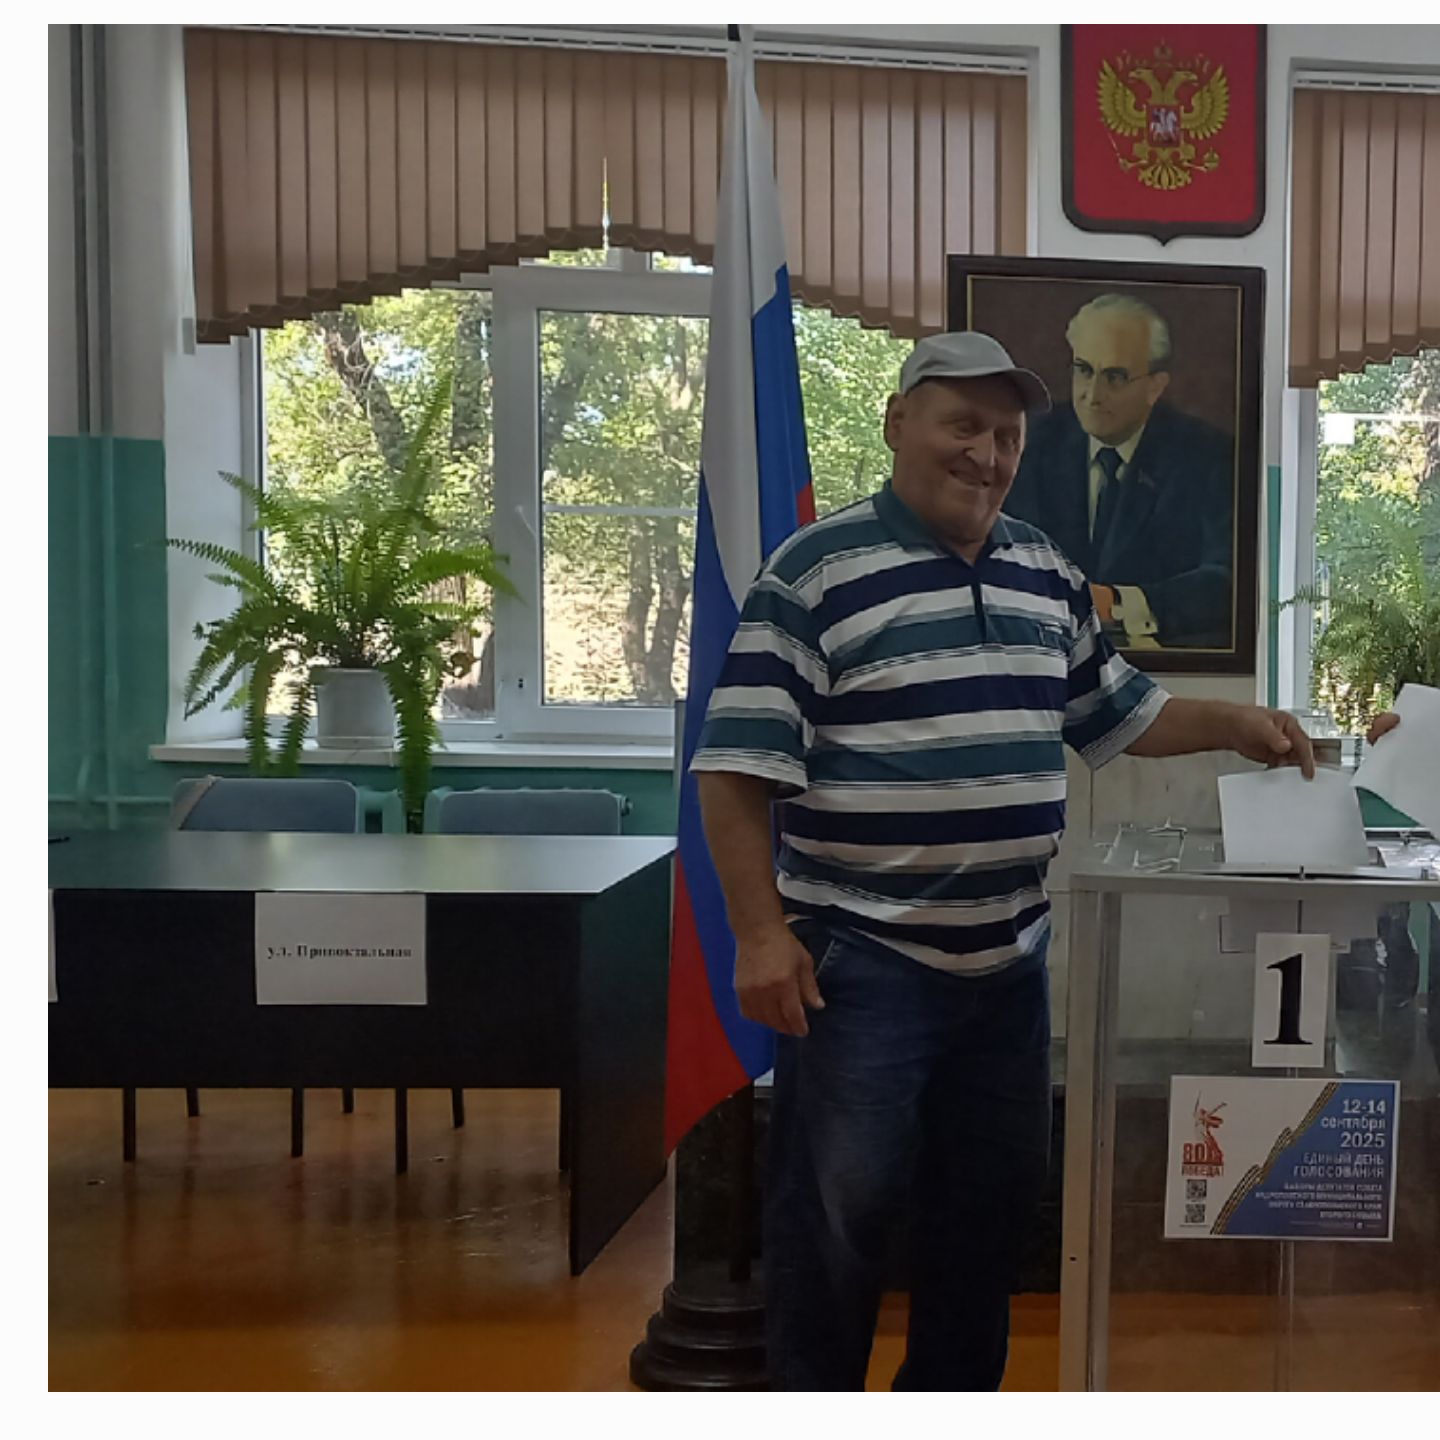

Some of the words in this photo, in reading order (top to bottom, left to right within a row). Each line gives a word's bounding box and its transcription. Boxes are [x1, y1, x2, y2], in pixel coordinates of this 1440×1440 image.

[1263, 953, 1313, 1045] 1
[1342, 1098, 1386, 1114] 12-14
[1320, 1114, 1386, 1132] сентября
[1340, 1131, 1385, 1148] 2025
[1183, 1142, 1206, 1162] 80
[1303, 1151, 1352, 1165] ЕДИНЫЙ
[1354, 1153, 1385, 1166] ДЕНЬ
[1293, 1165, 1385, 1178] ГОЛОСОВАНИЯ
